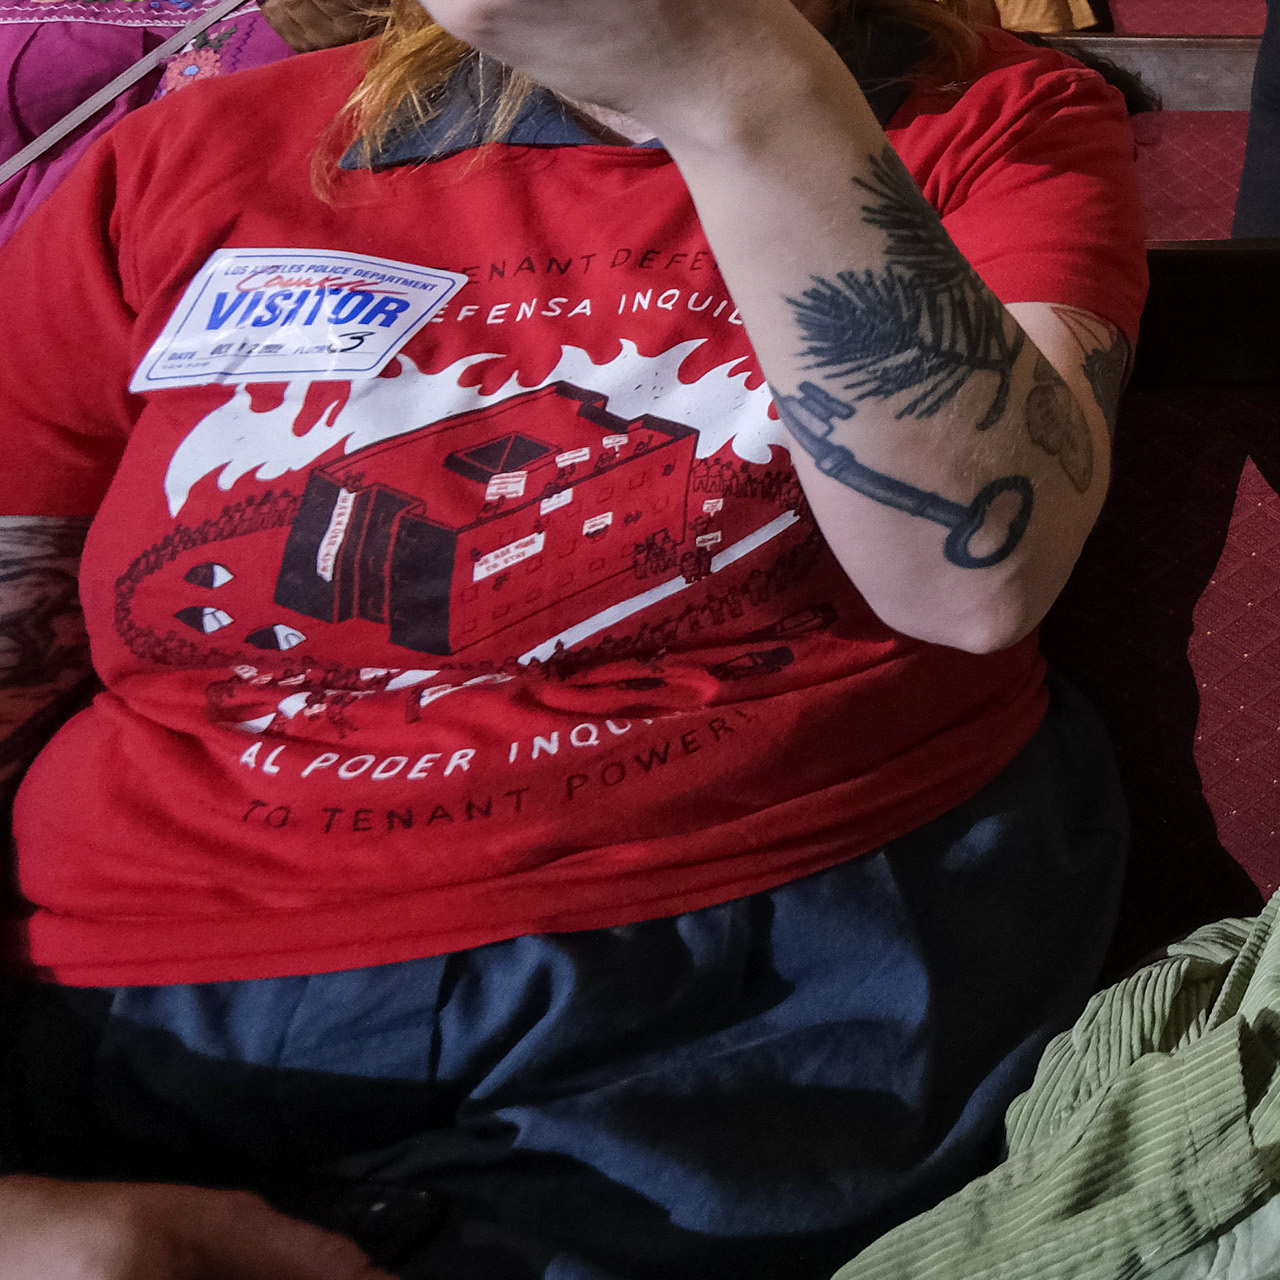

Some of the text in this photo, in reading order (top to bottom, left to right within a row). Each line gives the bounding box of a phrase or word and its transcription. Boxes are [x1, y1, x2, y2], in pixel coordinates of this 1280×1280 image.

[302, 264, 351, 276] POLICE
[353, 269, 438, 292] DEPARTMENT
[610, 248, 718, 271] DEFE
[206, 288, 410, 331] VISITOR
[430, 289, 743, 325] EFENSA INQUIL
[240, 719, 653, 781] AL PODER INQU
[243, 800, 290, 829] TO
[323, 788, 531, 833] TENANT
